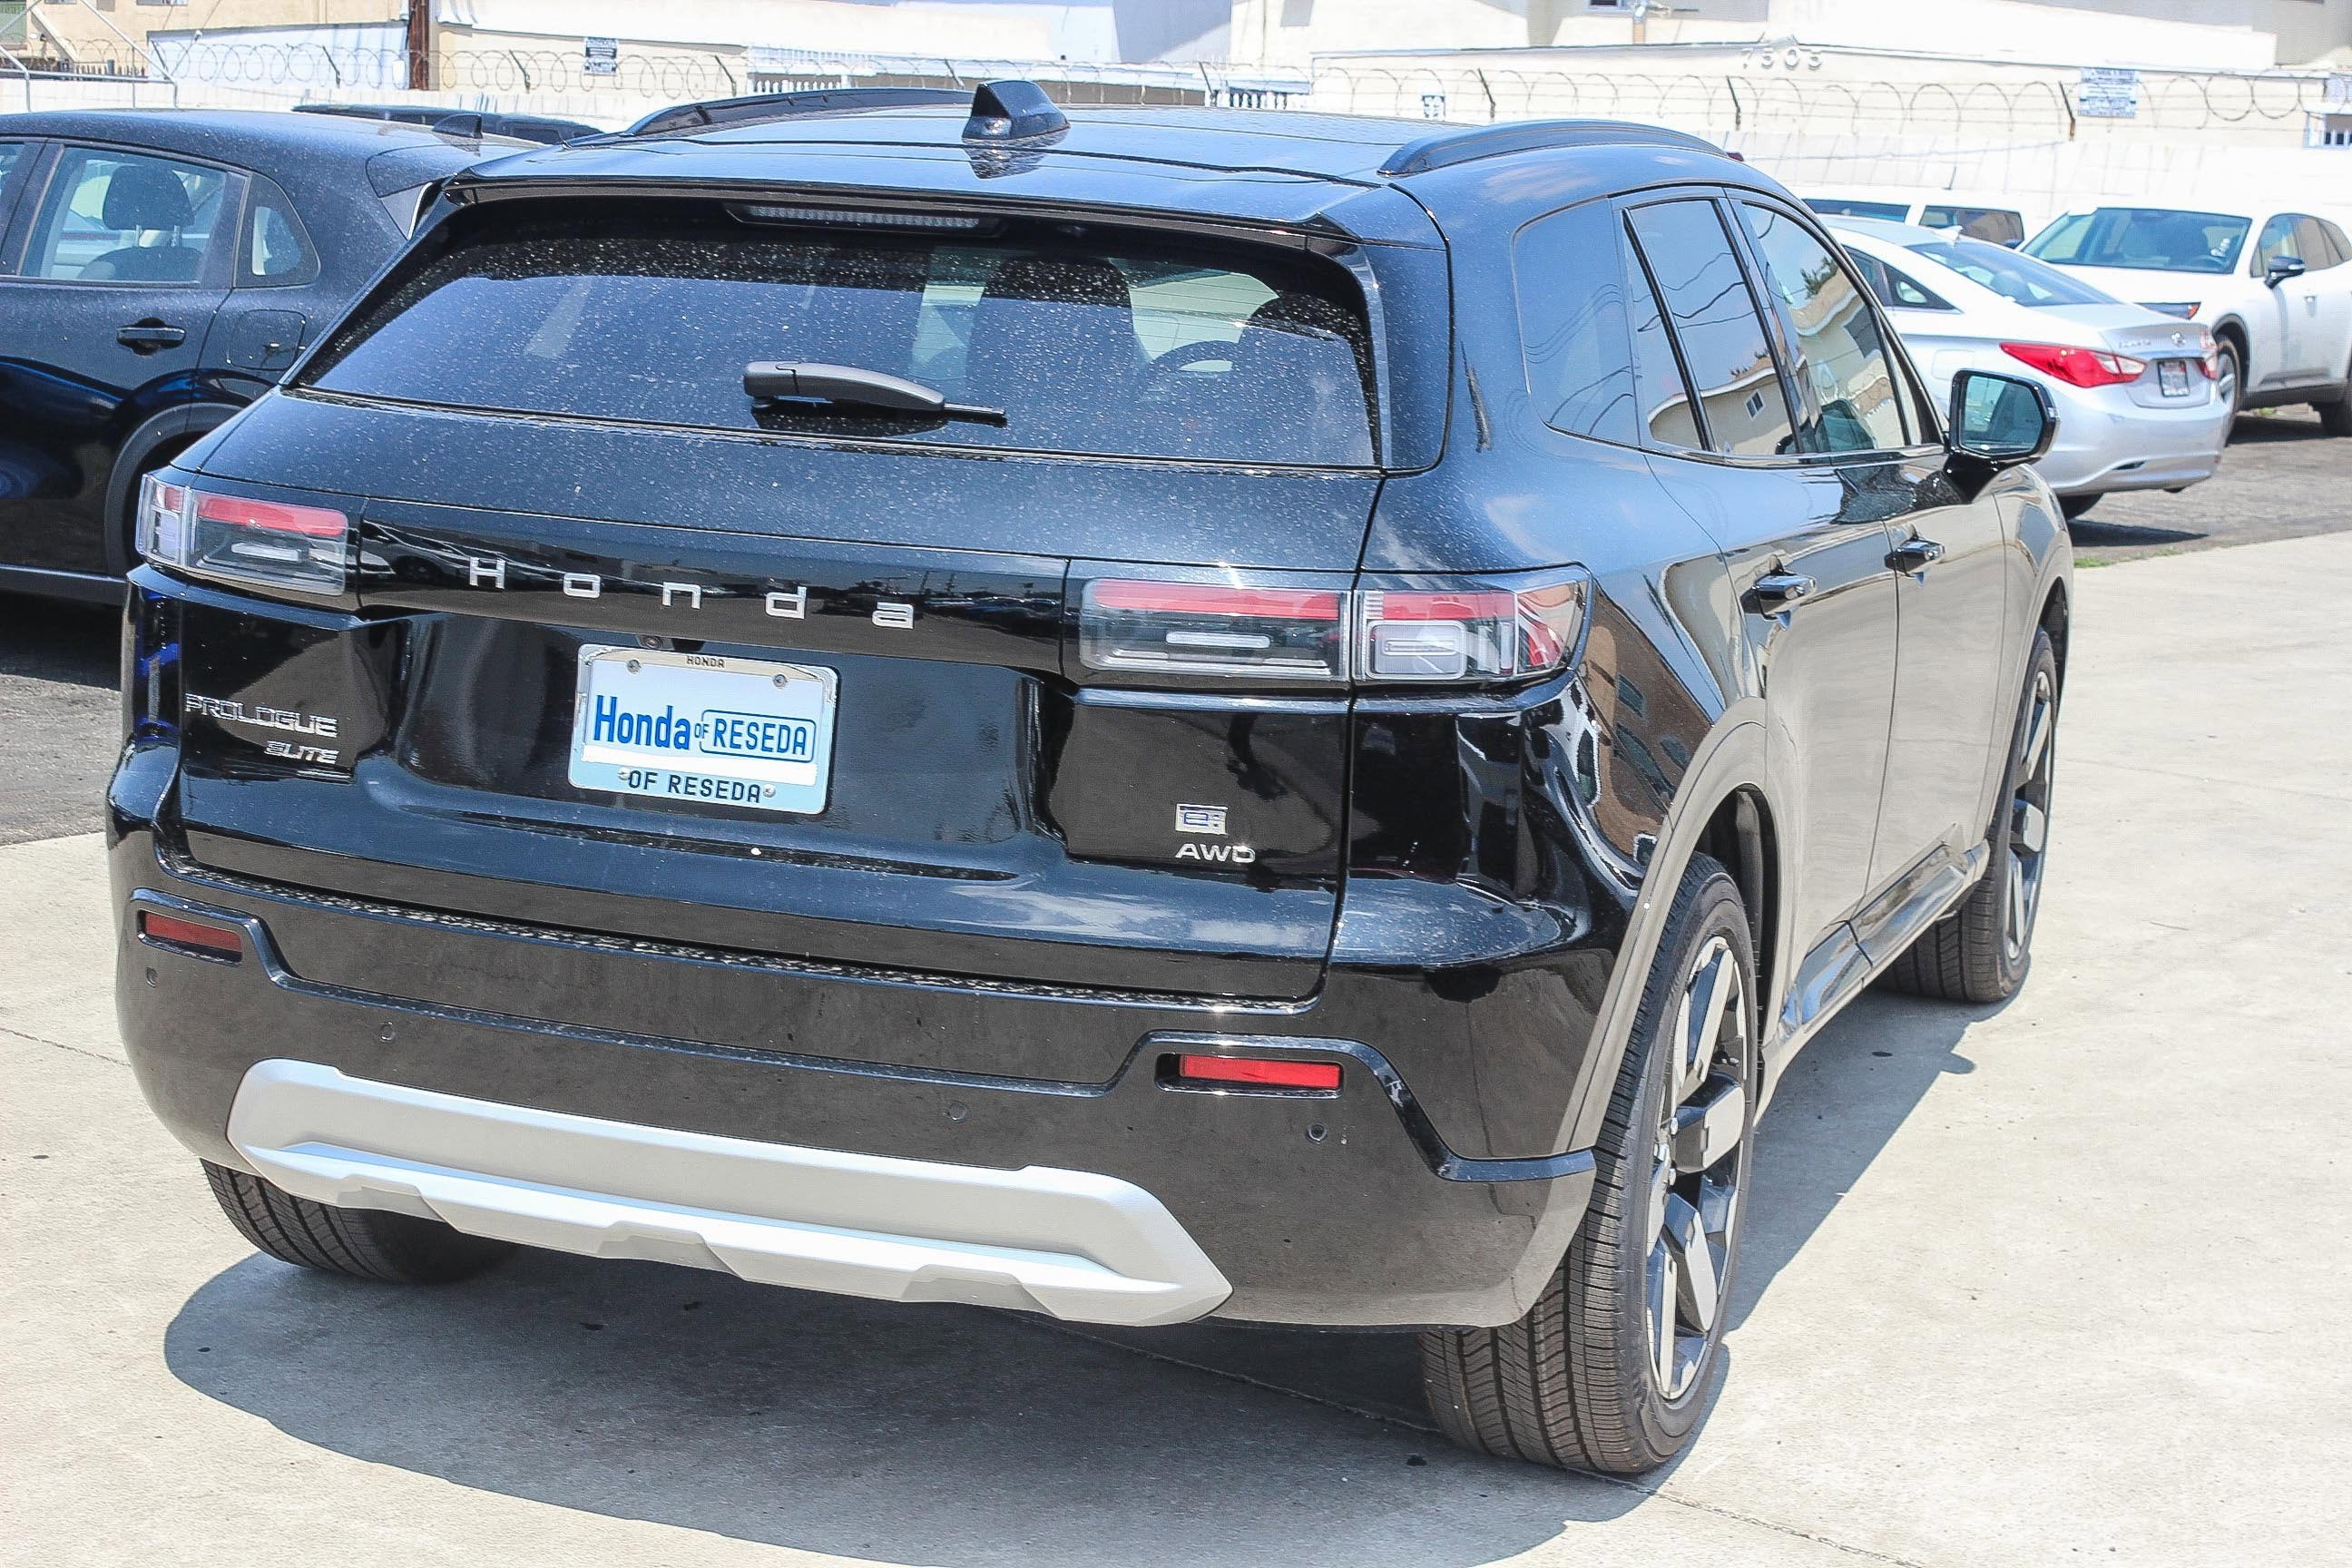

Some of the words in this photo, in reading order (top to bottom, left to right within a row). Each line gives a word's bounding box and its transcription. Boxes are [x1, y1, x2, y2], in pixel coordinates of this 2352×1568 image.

[468, 556, 916, 631] Honda
[686, 655, 726, 669] HONDA
[184, 692, 338, 739] PROLOGUE
[593, 694, 691, 750] Honda
[712, 718, 808, 756] RESEDA
[263, 740, 340, 765] ELITE
[627, 769, 659, 789] OF
[667, 774, 762, 804] RESEDA
[1174, 842, 1256, 864] AWD
